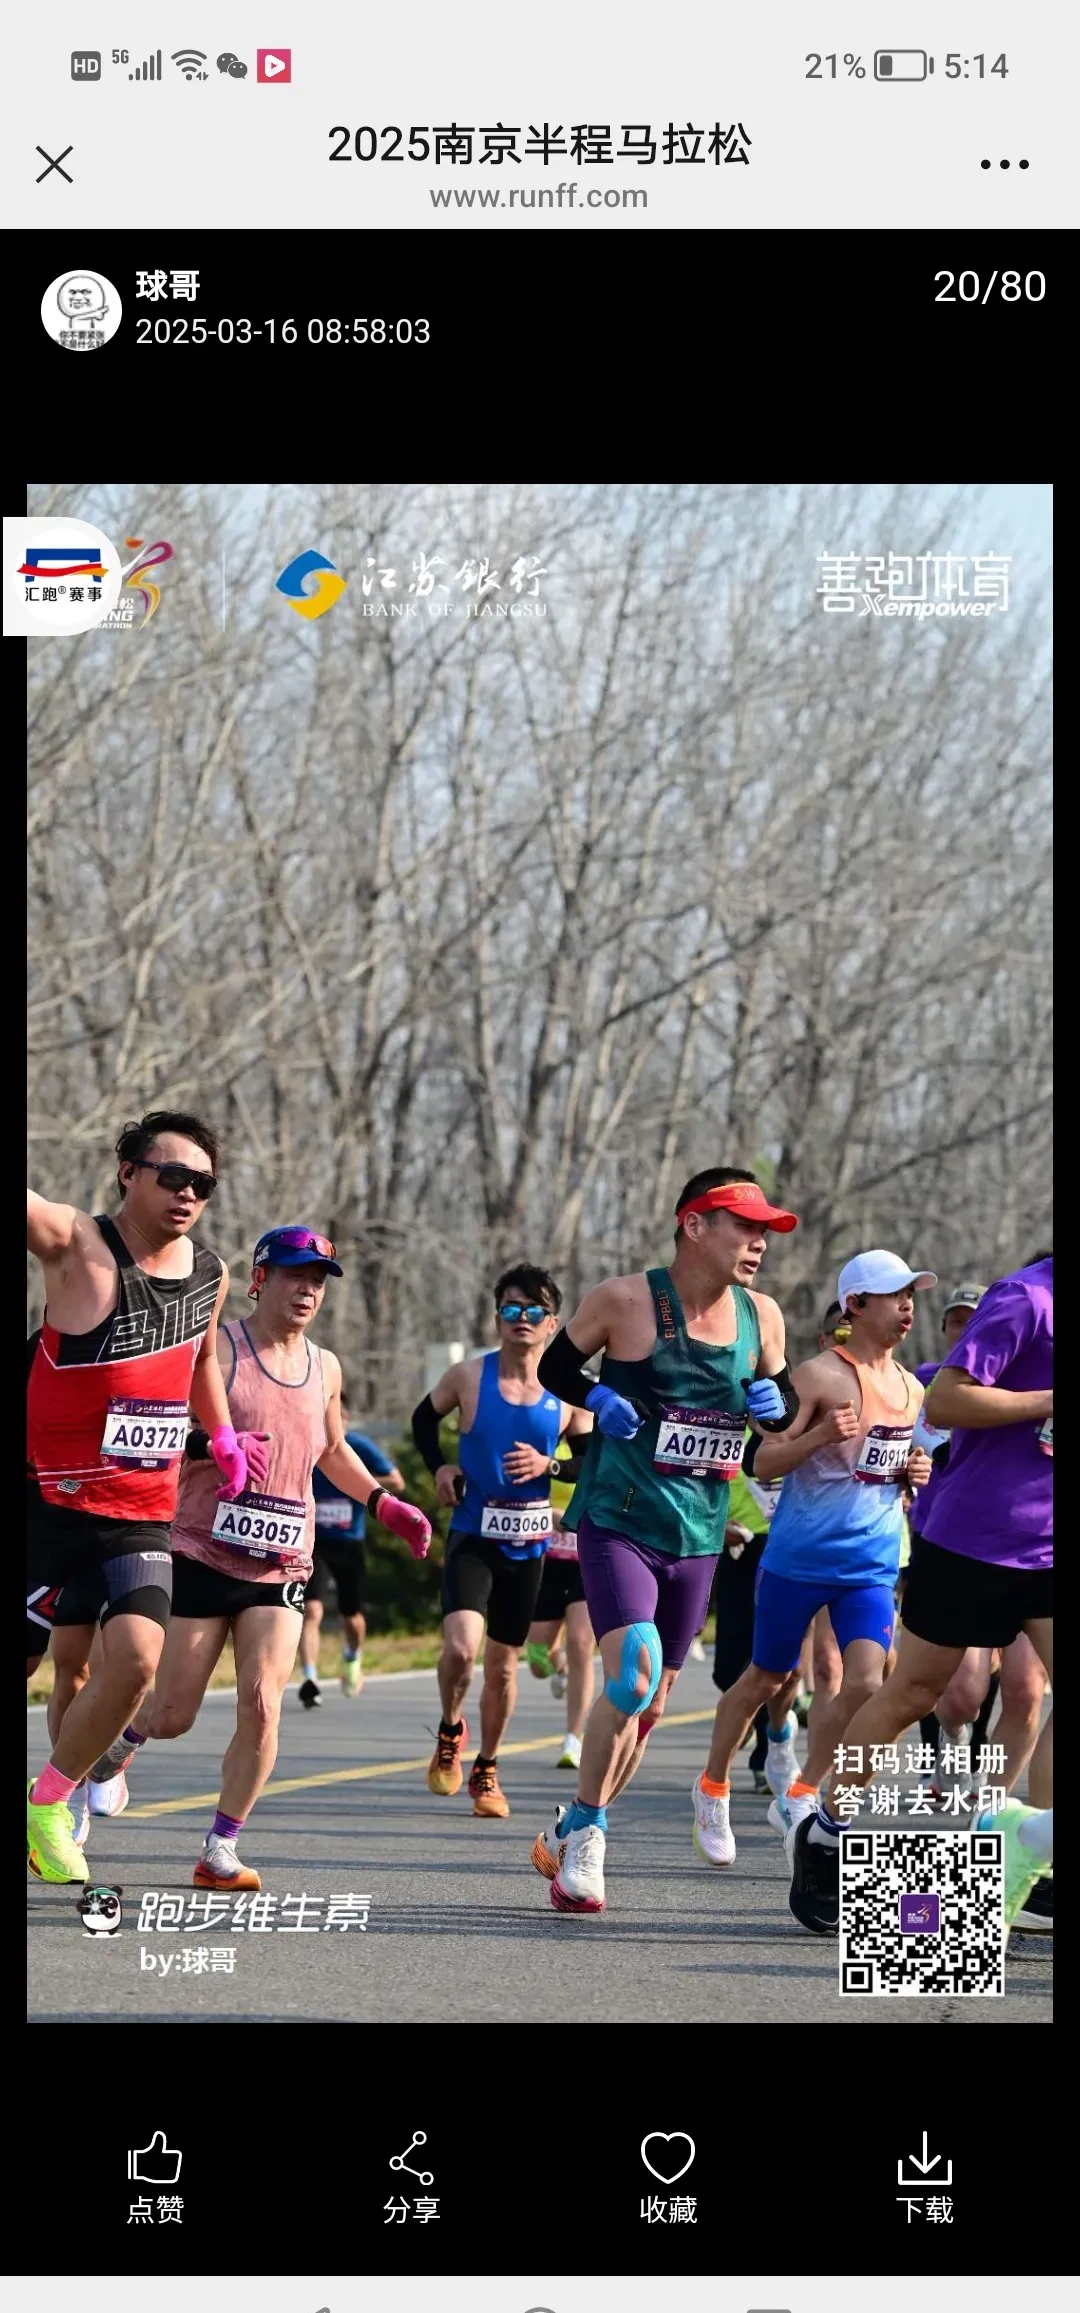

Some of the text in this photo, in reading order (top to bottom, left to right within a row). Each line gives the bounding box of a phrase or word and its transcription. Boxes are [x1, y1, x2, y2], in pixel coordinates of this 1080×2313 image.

[74, 58, 98, 73] HD
[112, 49, 129, 64] 5G
[805, 53, 866, 79] 21%
[944, 53, 1009, 79] 5:14
[328, 121, 753, 166] 2025南京半程马拉松
[429, 182, 648, 208] www.runff.com
[135, 269, 201, 302] 球哥
[934, 270, 1046, 305] 20/80
[136, 318, 430, 344] 2025-03-16 08:58:03
[111, 1424, 185, 1449] A03721
[663, 1432, 742, 1461] A01138
[220, 1512, 302, 1546] A03057
[487, 1515, 549, 1533] A03060
[126, 2195, 185, 2225] 点赞
[382, 2195, 441, 2224] 分享
[639, 2195, 698, 2224] 收藏
[895, 2195, 954, 2224] 下载
